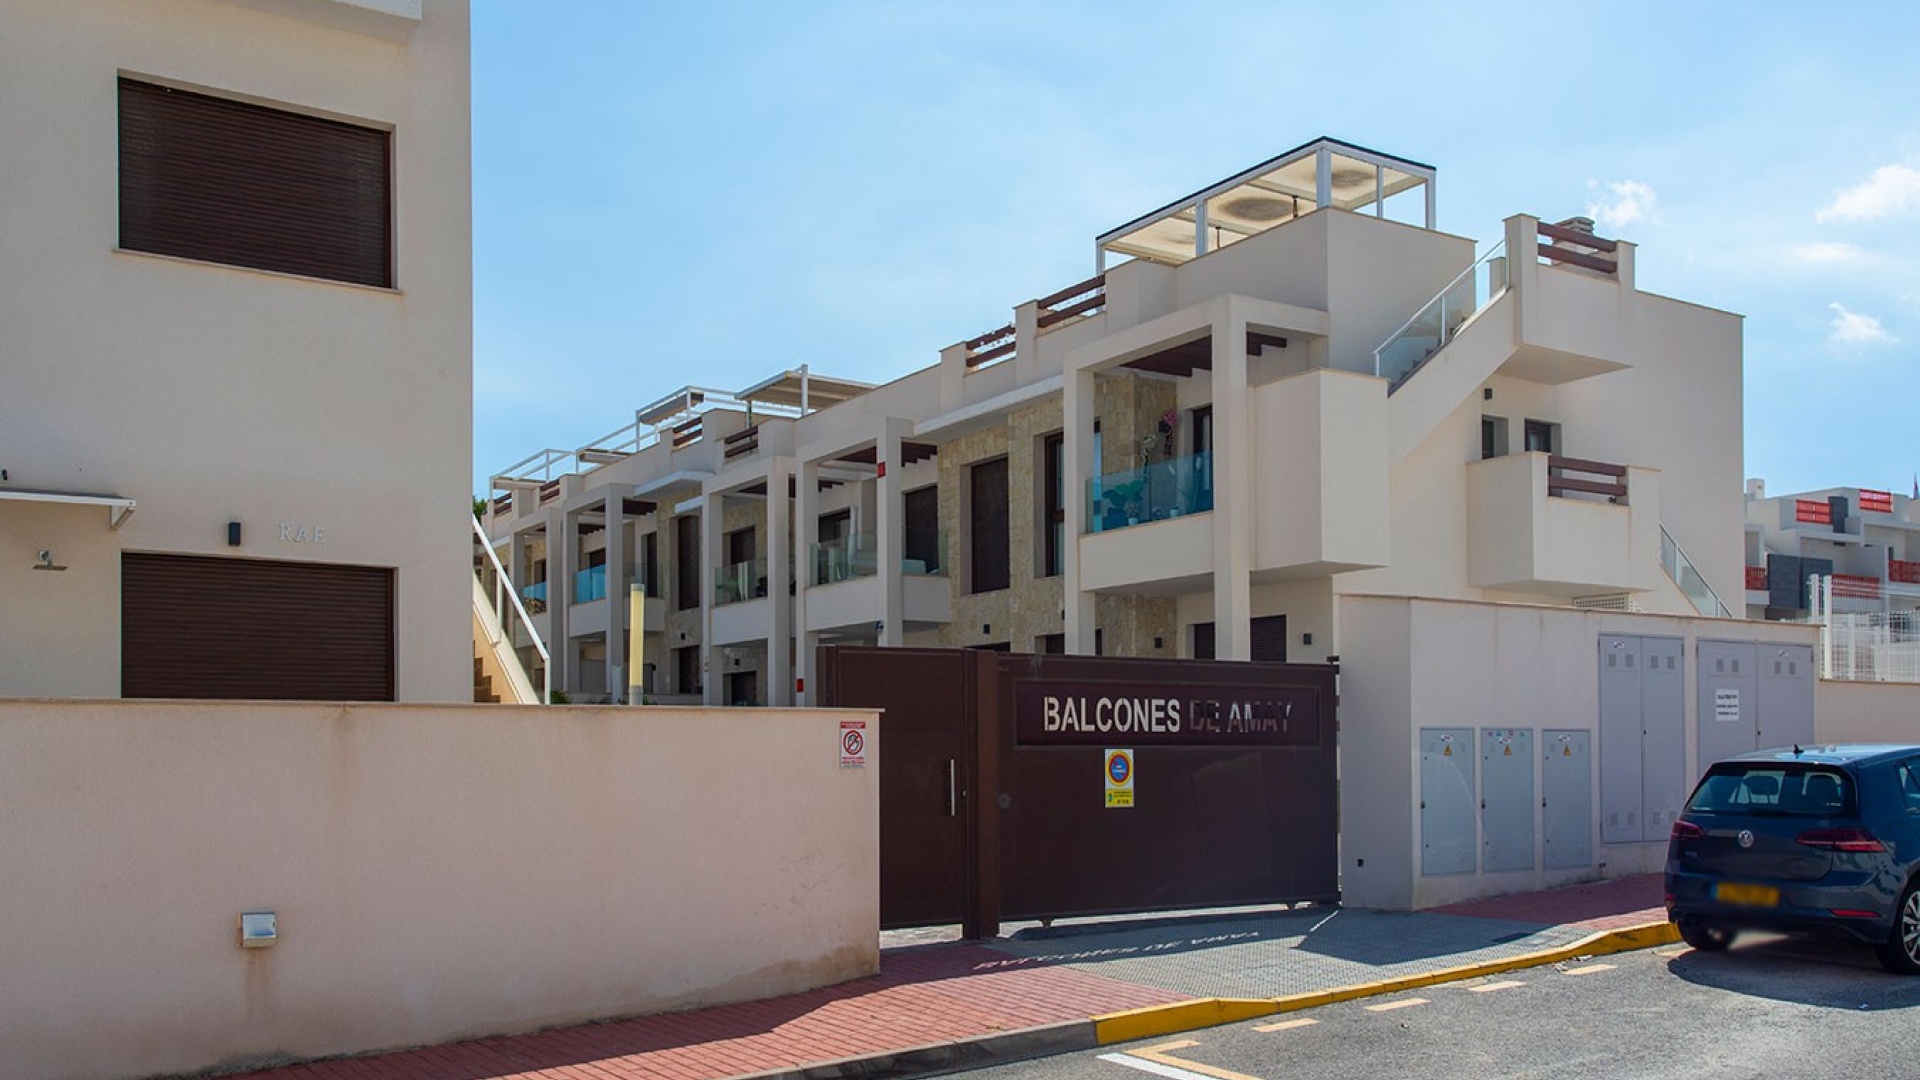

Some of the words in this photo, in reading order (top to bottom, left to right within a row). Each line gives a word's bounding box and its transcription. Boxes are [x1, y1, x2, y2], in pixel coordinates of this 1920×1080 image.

[1044, 697, 1180, 732] BALCONES
[1189, 699, 1220, 732] DE
[1226, 700, 1293, 732] AMAY
